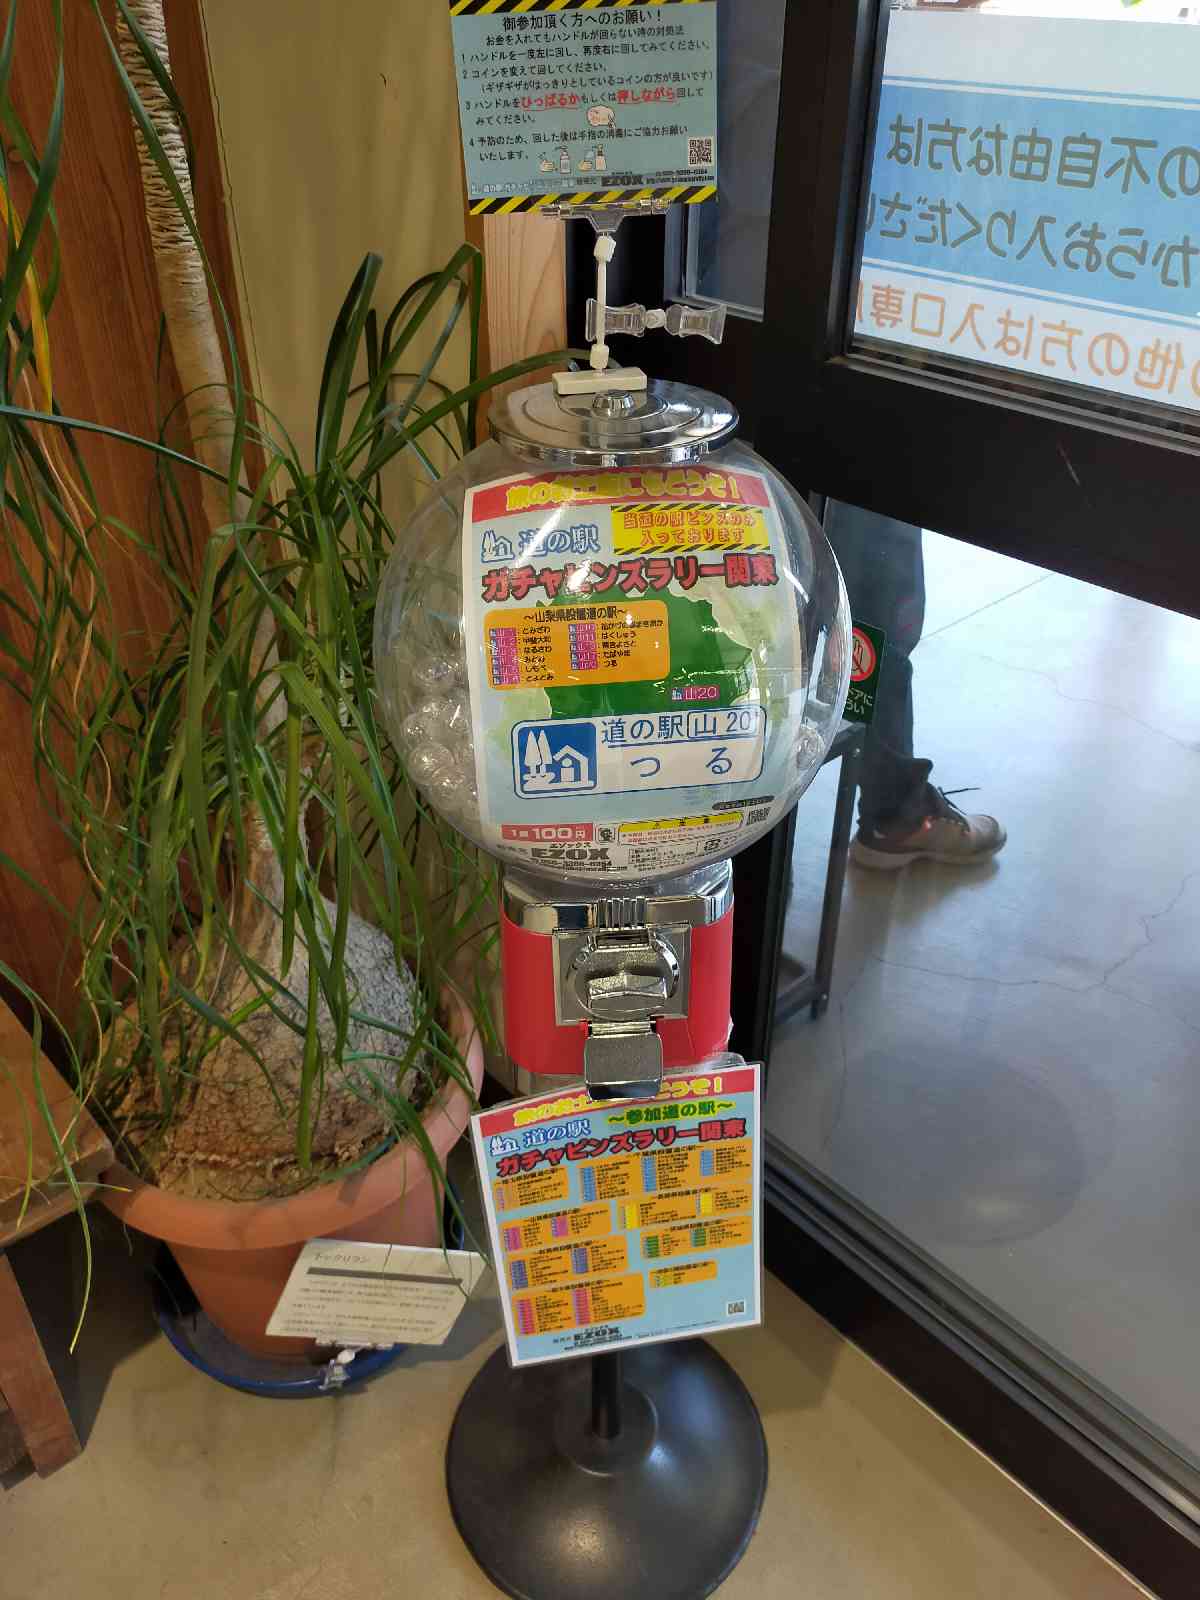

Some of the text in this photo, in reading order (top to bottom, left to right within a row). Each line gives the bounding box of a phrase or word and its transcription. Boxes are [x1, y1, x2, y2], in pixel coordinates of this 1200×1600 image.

[475, 114, 537, 125] みてください。
[479, 151, 529, 161] いたします。
[518, 523, 600, 557] 道の駅
[684, 686, 717, 700] 山20
[601, 715, 683, 745] 道の駅
[630, 746, 732, 778] つる
[531, 848, 610, 861] EZOX
[523, 1119, 592, 1147] 道の駅
[496, 1118, 747, 1177] ガチャピンズラリー関東
